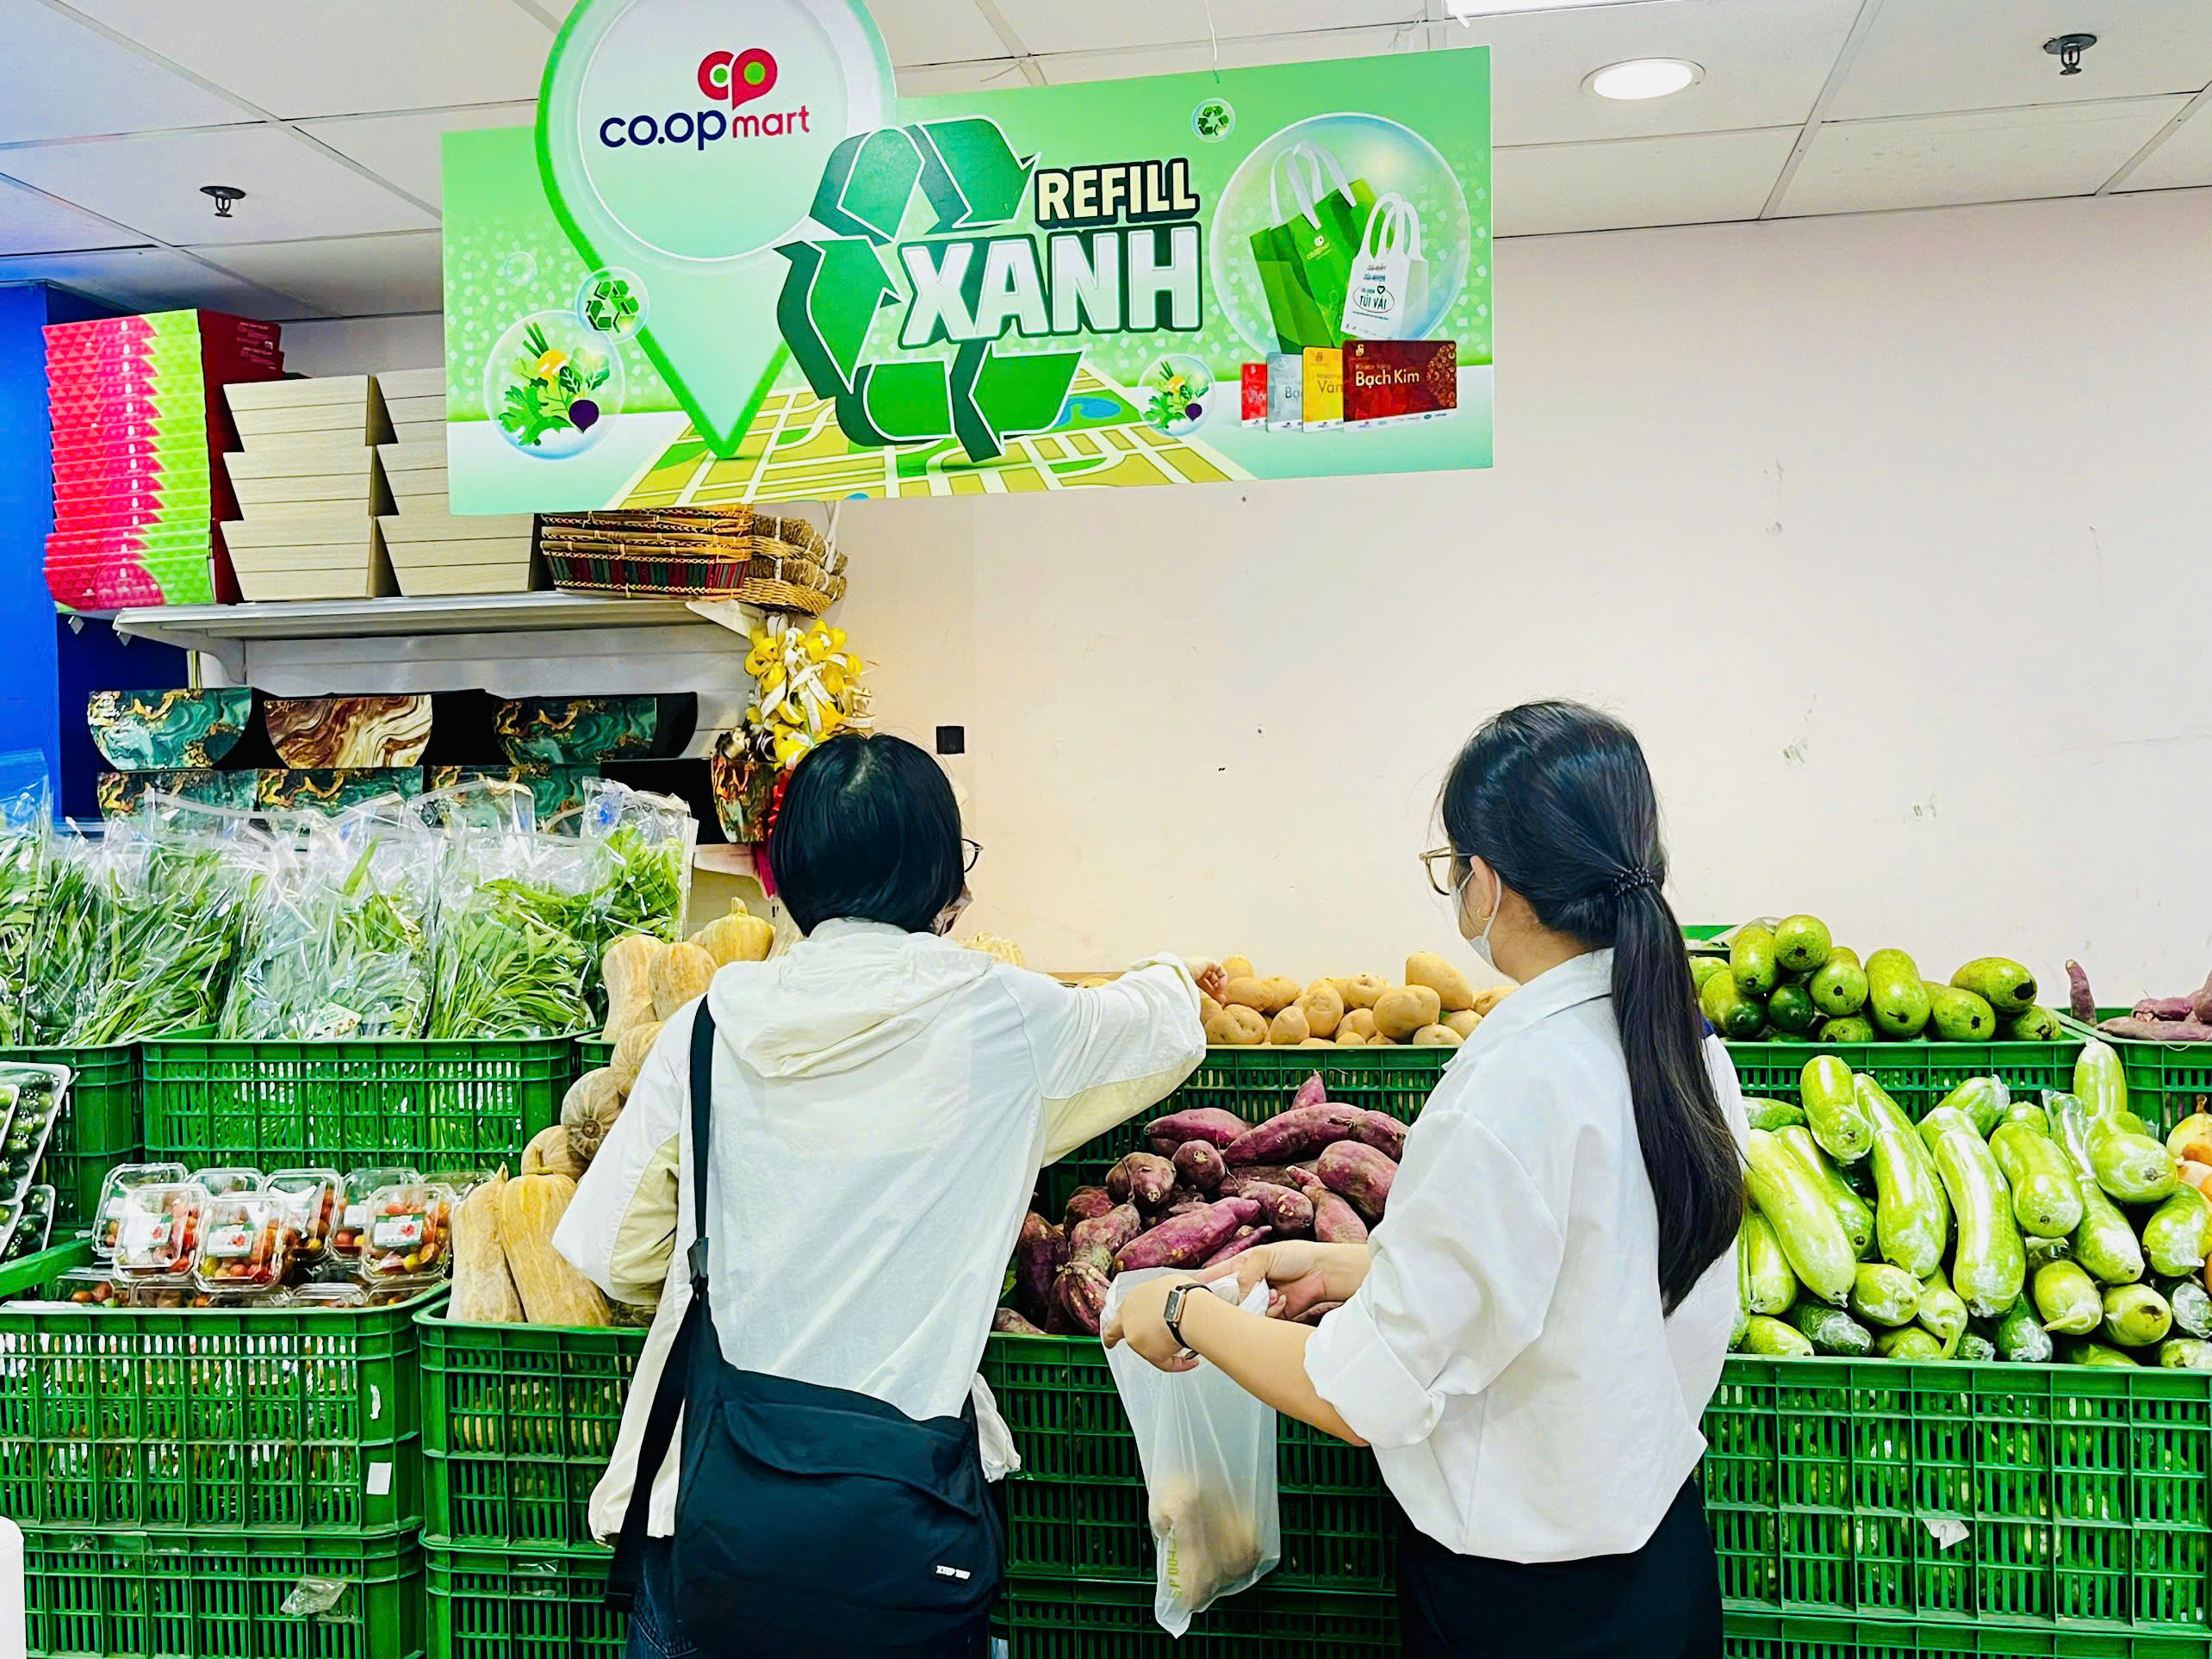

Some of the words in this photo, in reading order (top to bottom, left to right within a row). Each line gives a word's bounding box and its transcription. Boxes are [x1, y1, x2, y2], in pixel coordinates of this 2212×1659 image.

[1037, 160, 1198, 224] REFILL
[900, 224, 1200, 346] XANH
[1355, 369, 1391, 389] Bạch
[1394, 368, 1420, 384] Kim
